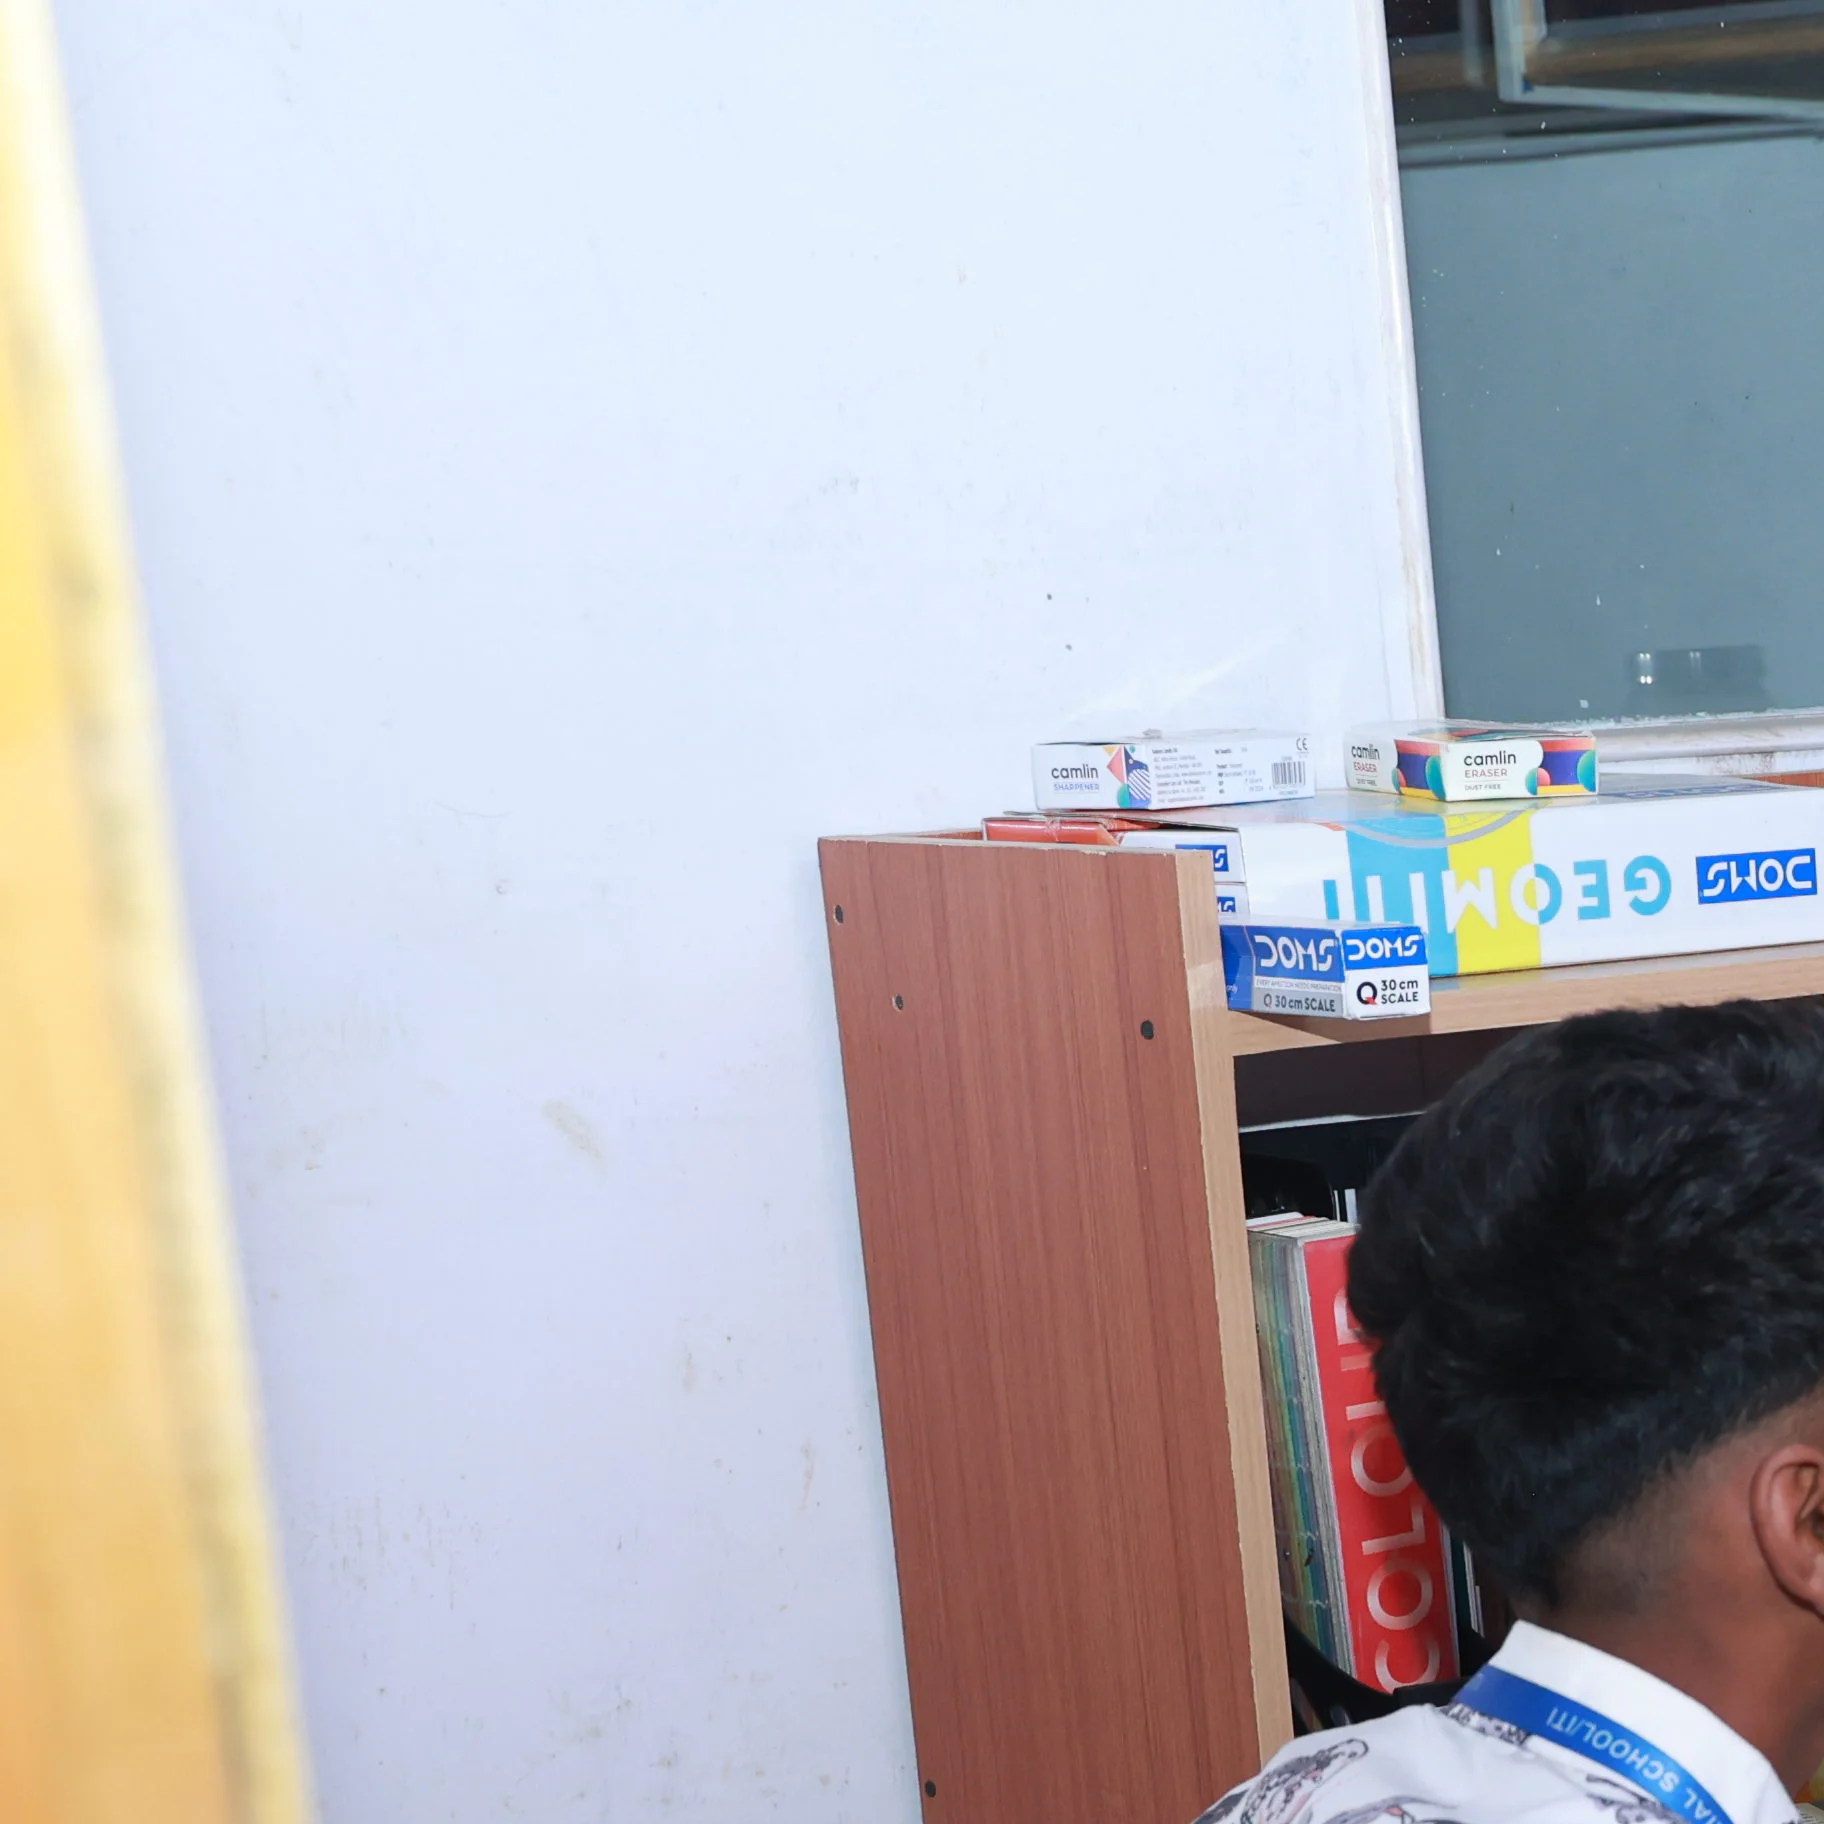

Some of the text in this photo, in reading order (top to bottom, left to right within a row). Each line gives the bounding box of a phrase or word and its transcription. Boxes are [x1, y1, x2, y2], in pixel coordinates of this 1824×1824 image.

[1352, 744, 1381, 761] camlin
[1464, 751, 1517, 767] camlin
[1051, 764, 1099, 780] camlin
[1353, 761, 1378, 773] ERASER
[1465, 768, 1508, 779] ERASER
[1053, 783, 1100, 792] SHARPENER
[1702, 854, 1815, 897] DOMS
[1254, 935, 1336, 972] DOMS
[1345, 935, 1420, 961] DOMS
[1380, 979, 1419, 991] 30 cm
[1275, 995, 1287, 1010] 30
[1288, 999, 1303, 1011] cm
[1304, 996, 1336, 1012] SCALE
[1380, 991, 1419, 1005] SCALE
[1546, 1706, 1680, 1793] SCHOOL/ITI
